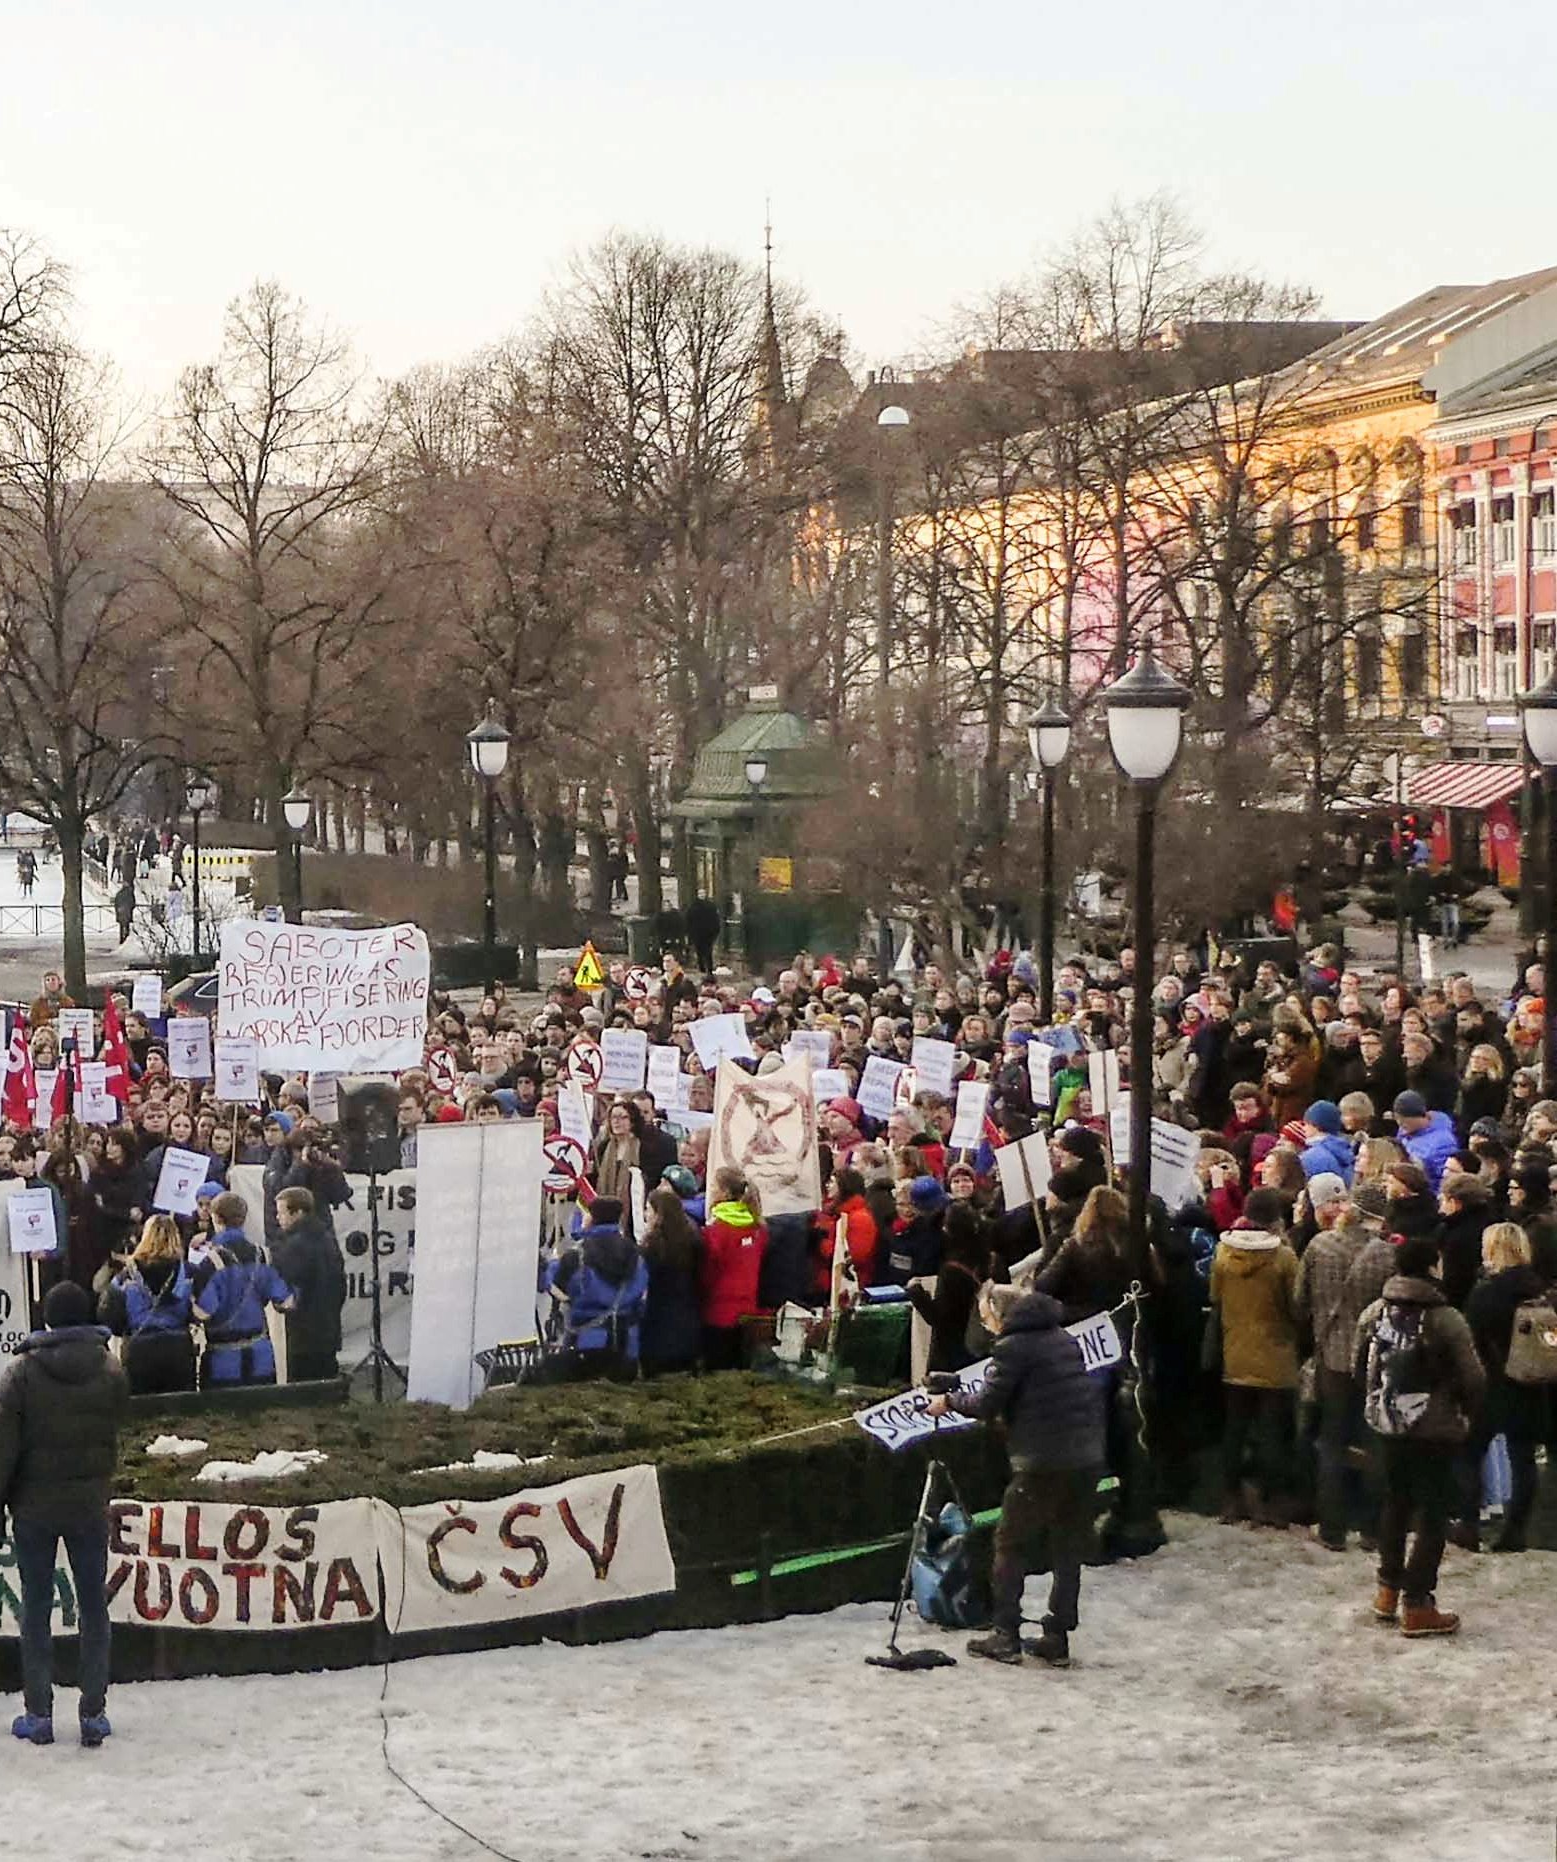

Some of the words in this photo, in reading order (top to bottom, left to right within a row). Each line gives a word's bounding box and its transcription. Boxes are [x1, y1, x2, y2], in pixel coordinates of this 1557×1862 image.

[239, 927, 416, 964] SABOTER
[223, 978, 425, 1011] TRUMPIFISERING
[294, 1008, 328, 1028] AV
[320, 1015, 423, 1050] FJORDER
[108, 1503, 320, 1562] ELLOS
[427, 1483, 625, 1594] ČSV
